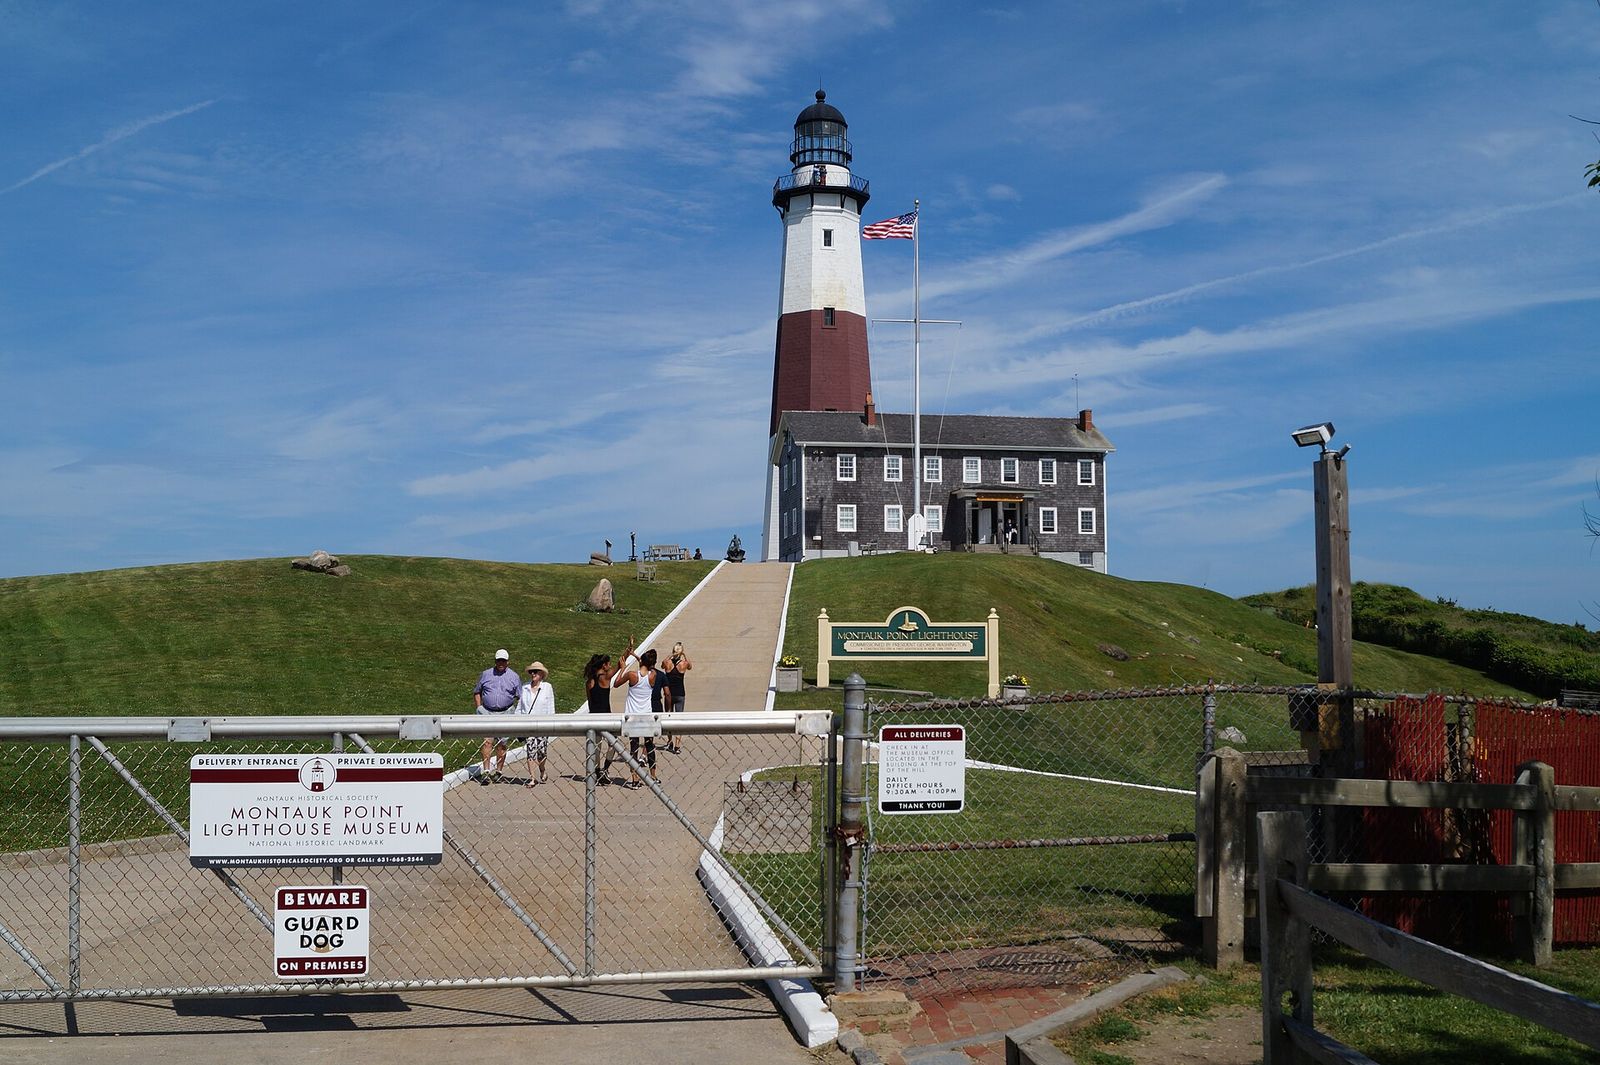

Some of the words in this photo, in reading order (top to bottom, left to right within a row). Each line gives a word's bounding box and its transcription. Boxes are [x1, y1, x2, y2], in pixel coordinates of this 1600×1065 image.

[838, 632, 884, 640] MONTAUK
[886, 632, 915, 640] POINT
[918, 631, 979, 640] LIGHTHOUSE
[230, 806, 332, 820] MONTAUK
[344, 805, 404, 819] POINT
[203, 823, 332, 837] LIGHTHOUSE
[344, 822, 430, 835] MUSEUM
[284, 892, 360, 905] BEWARE
[284, 916, 359, 931] GUARD
[300, 934, 344, 948] DOG
[280, 962, 298, 970] ON
[304, 961, 364, 970] PREMISES
